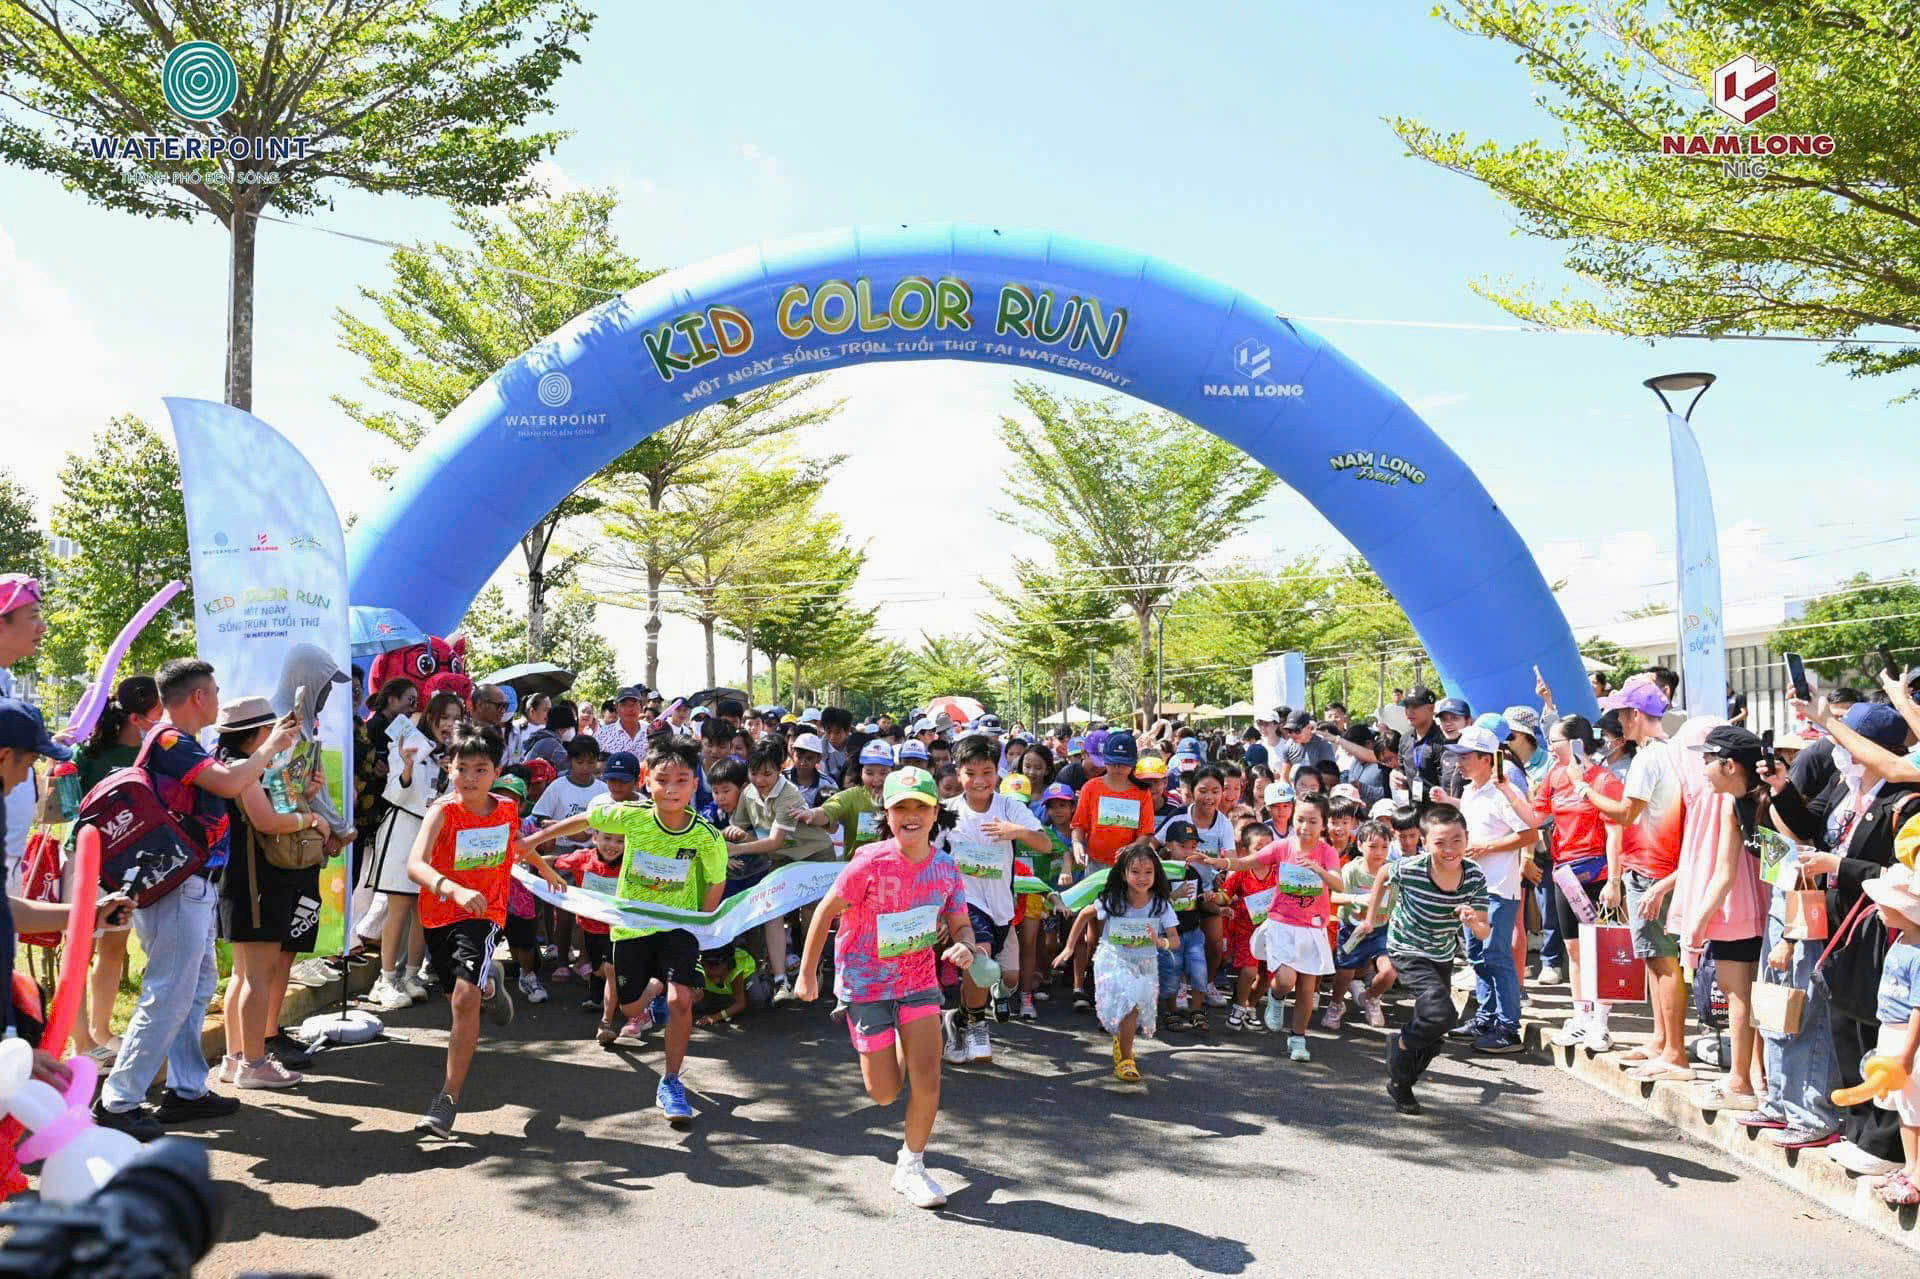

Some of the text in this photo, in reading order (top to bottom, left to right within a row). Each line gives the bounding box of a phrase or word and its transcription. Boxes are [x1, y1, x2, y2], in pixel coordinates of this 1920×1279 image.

[642, 276, 1129, 383] KID COLOR RUN
[683, 335, 1132, 403] MỘT NGÀY SỐNG TRỌN TUỔI THƠ TẠI WATERPOINT
[1203, 384, 1304, 397] NAM LONG
[505, 413, 607, 426] WATERPOINT
[1329, 452, 1427, 485] NAM LONG
[296, 589, 330, 609] RUN
[290, 910, 319, 938] adid
